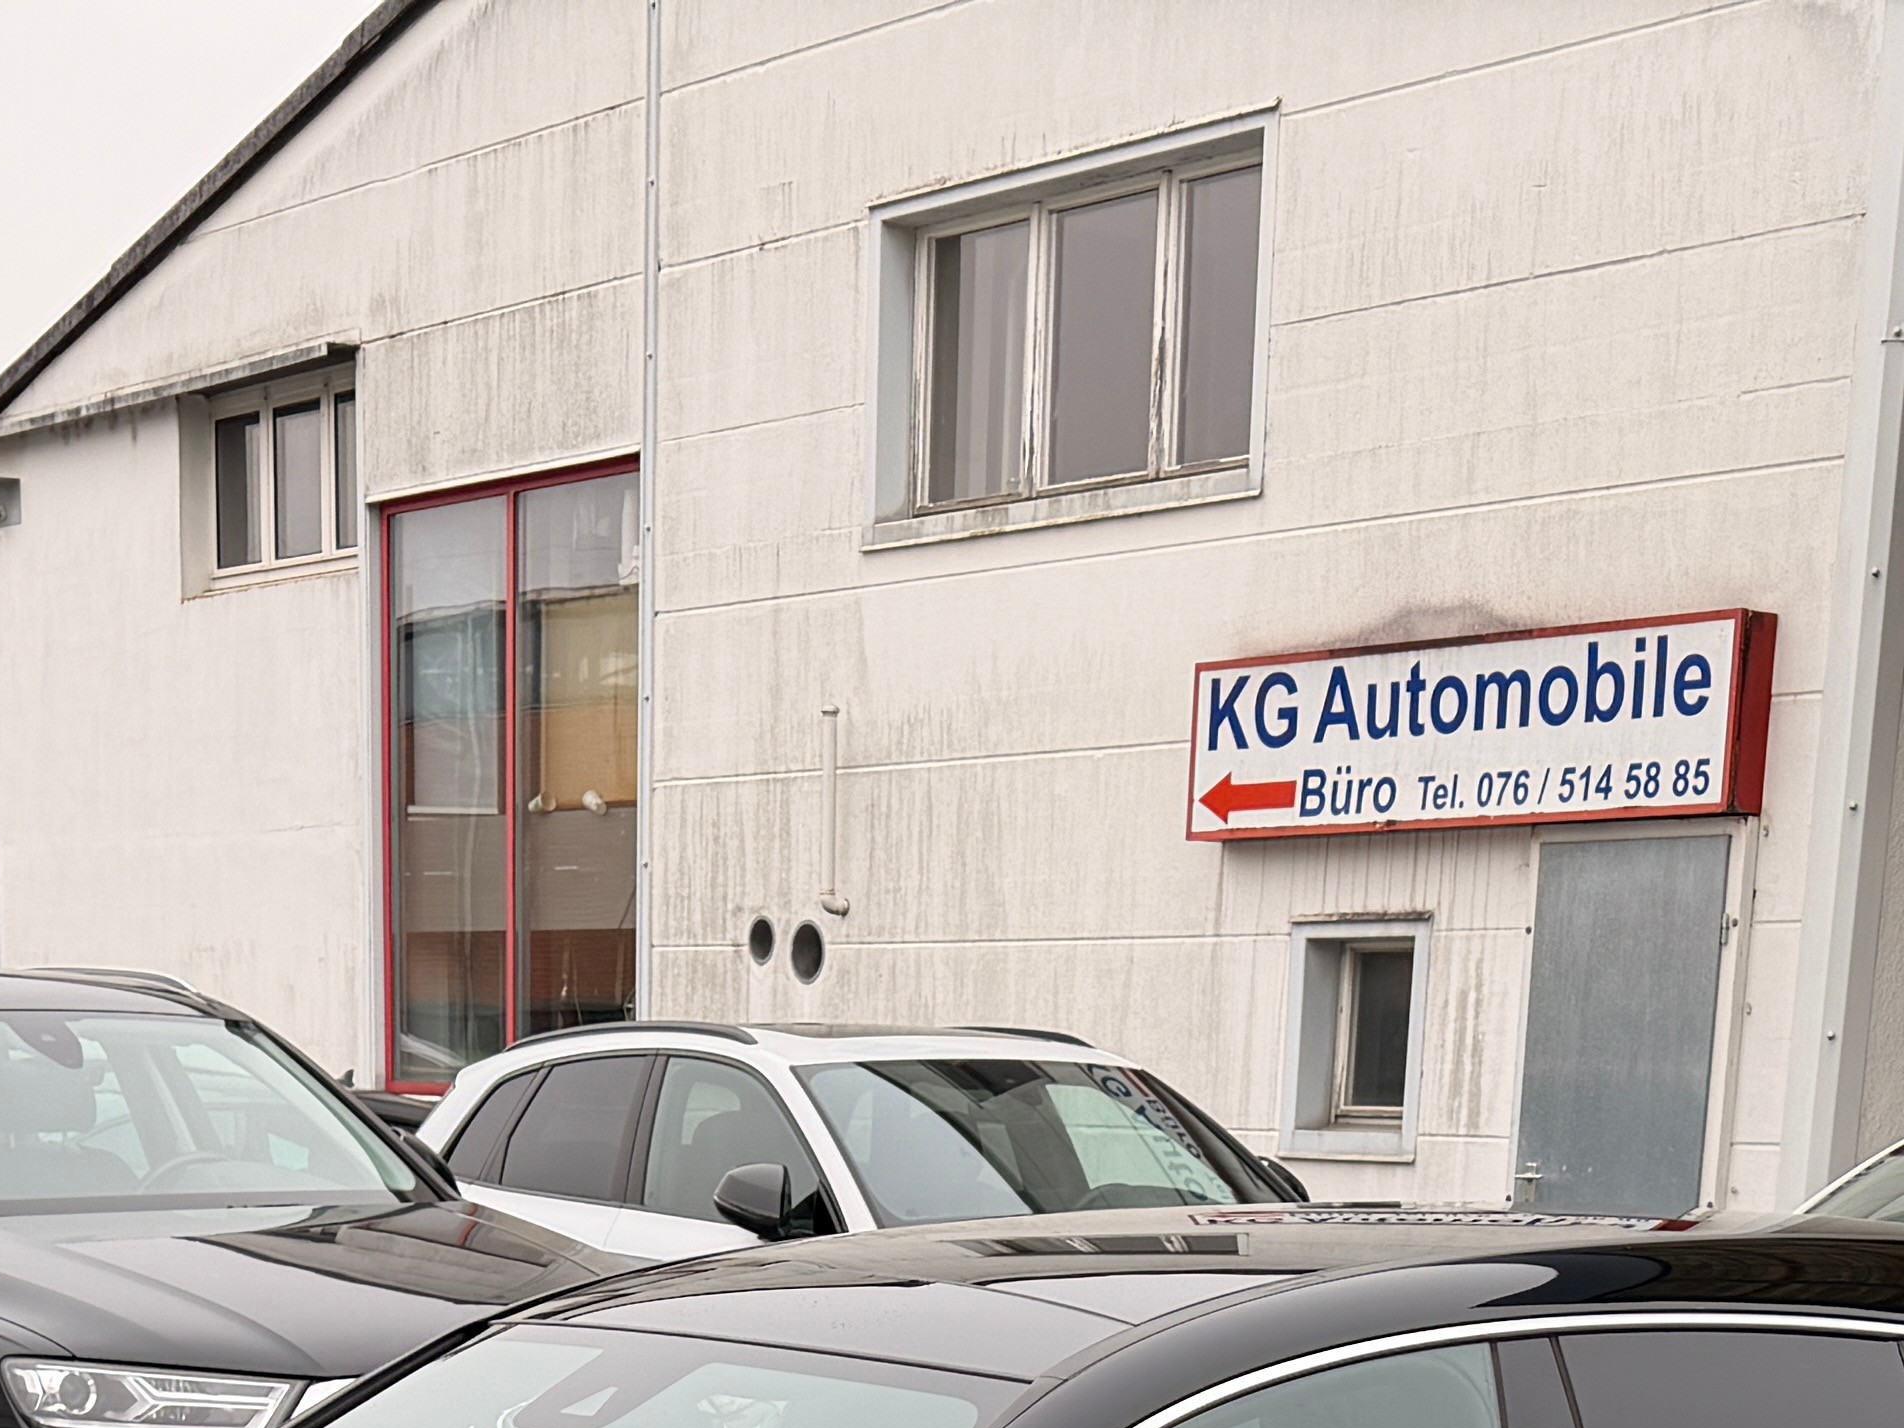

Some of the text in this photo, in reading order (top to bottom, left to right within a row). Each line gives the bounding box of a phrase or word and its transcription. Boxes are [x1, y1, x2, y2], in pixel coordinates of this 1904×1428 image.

[1206, 635, 1713, 751] KG Automobile
[1299, 758, 1711, 818] Büro Tel. 076 / 514 58 85
